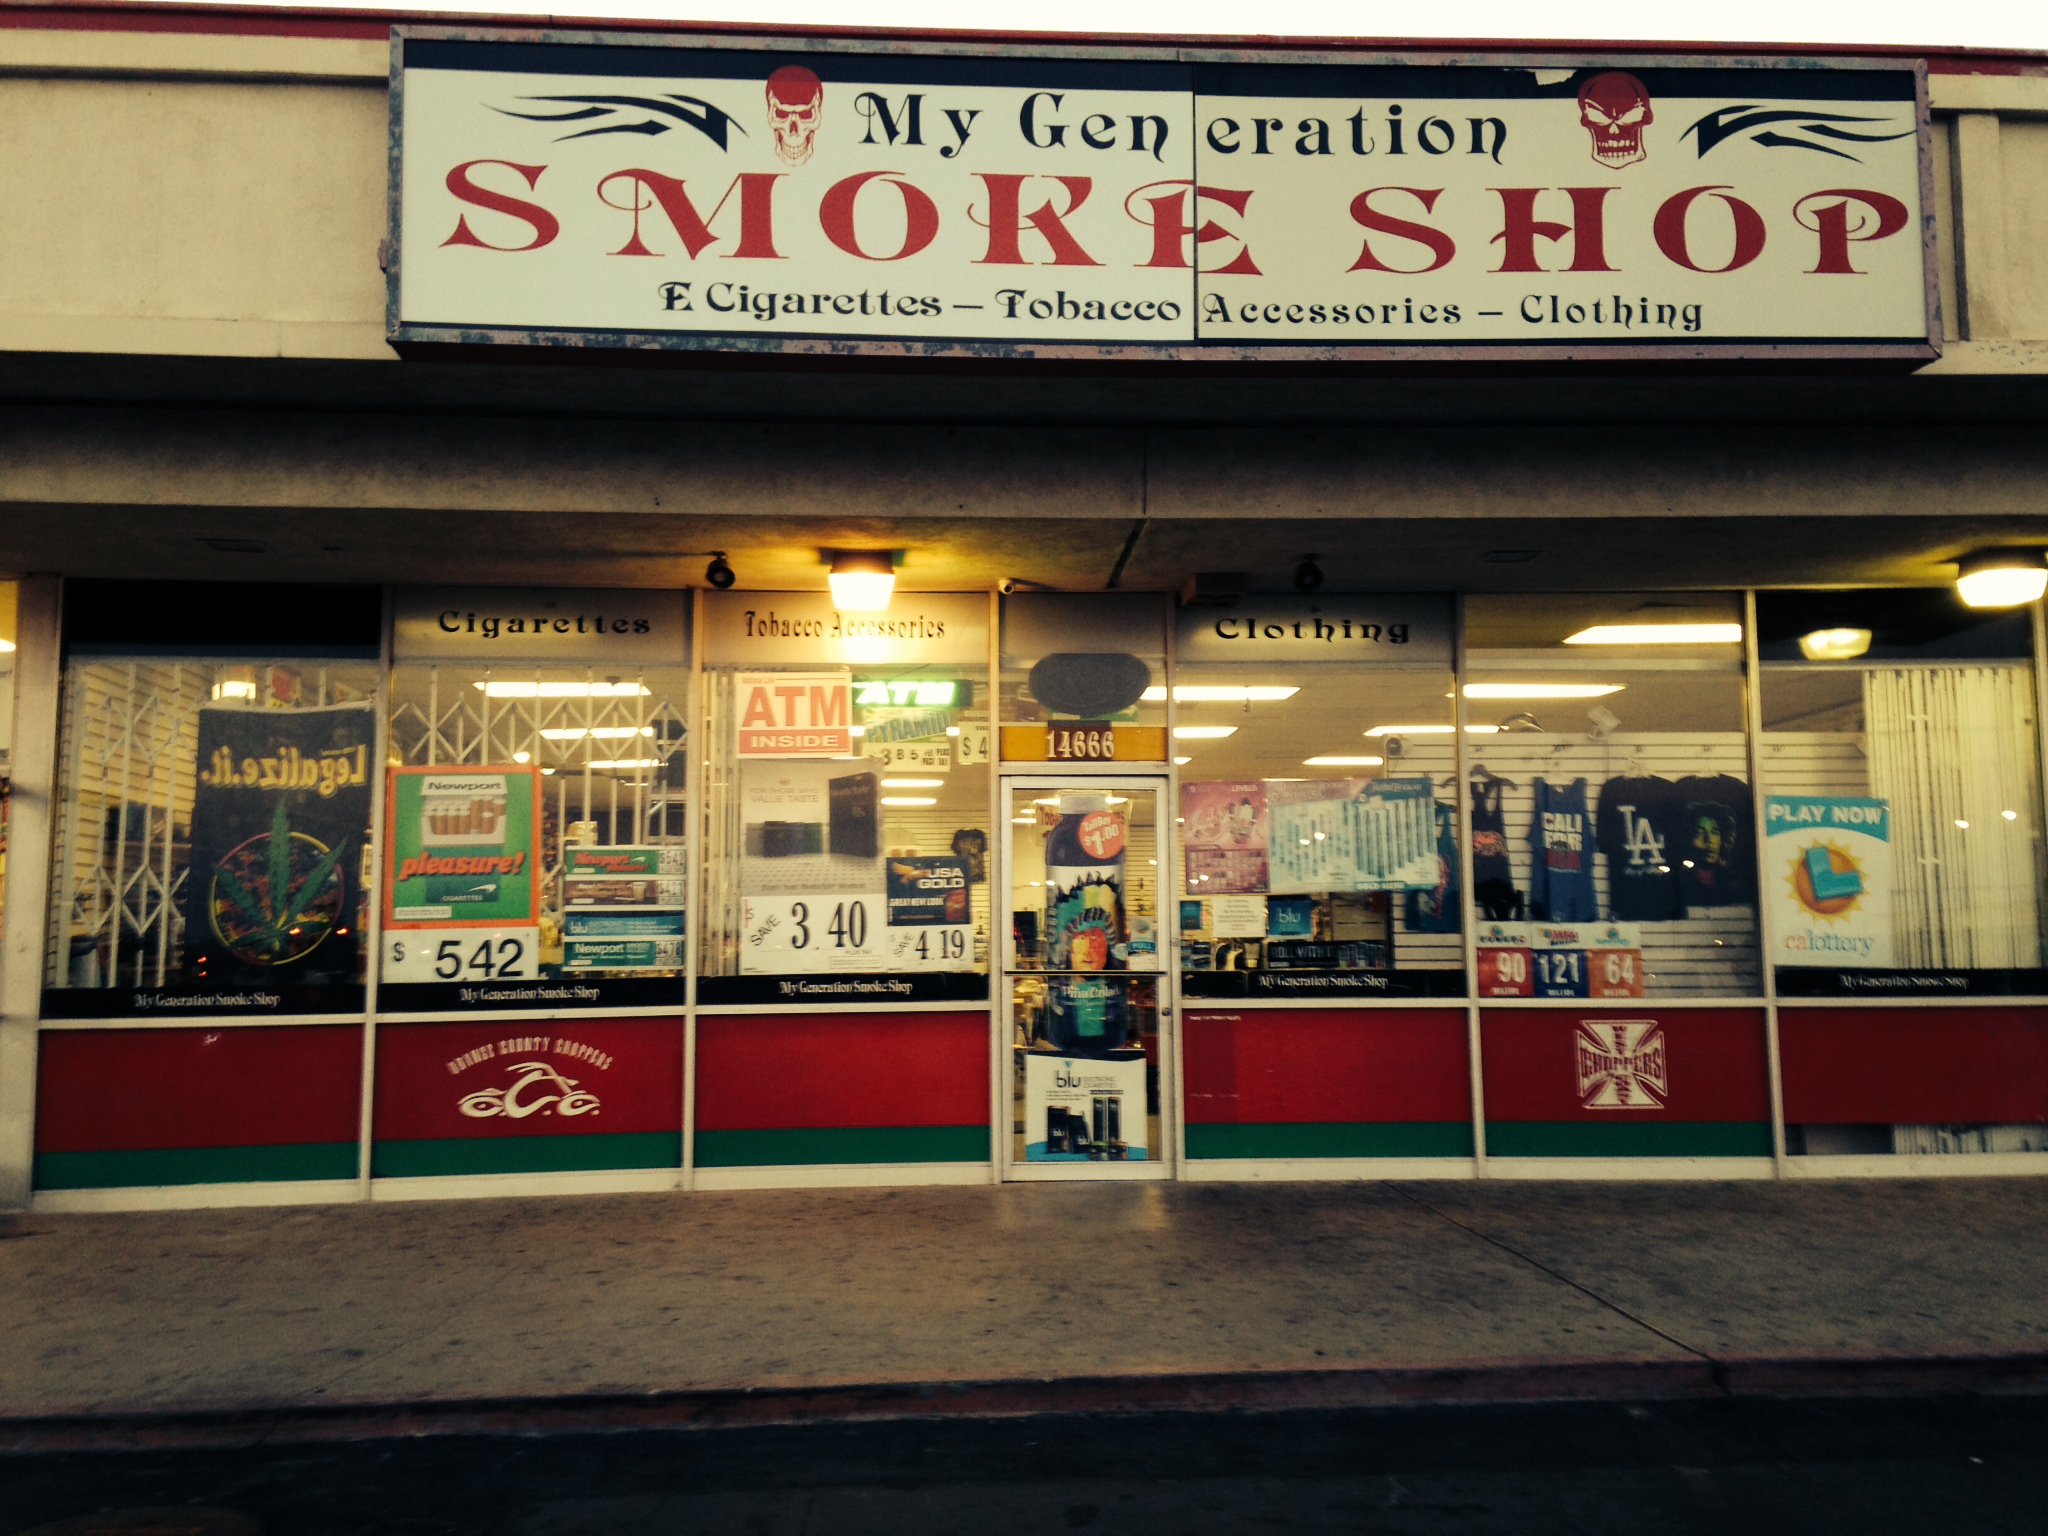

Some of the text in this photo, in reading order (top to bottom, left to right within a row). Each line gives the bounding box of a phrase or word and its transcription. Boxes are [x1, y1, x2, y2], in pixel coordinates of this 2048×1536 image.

[855, 91, 1508, 166] My Generation
[438, 158, 1909, 276] SMOKE SHOP
[659, 281, 693, 312] E
[705, 283, 943, 322] Cigarettes
[995, 288, 1182, 322] Tobacco
[1202, 293, 1463, 325] Accessories
[1520, 294, 1703, 332] Clothing
[439, 609, 651, 639] Cigarettes
[745, 610, 946, 639] Tobacco Accessories
[1215, 616, 1410, 645] Clothing
[852, 681, 956, 705] ATM
[742, 685, 848, 728] ATM
[751, 734, 839, 749] INSIDE
[1047, 730, 1115, 758] 14666
[428, 781, 503, 791] Newport
[751, 795, 819, 803] VALUE TASTE
[1541, 811, 1583, 833] CALI
[1768, 803, 1882, 825] PLAY NOW
[1542, 830, 1583, 852] FOR
[1616, 804, 1667, 866] LA
[396, 851, 527, 882] pleasure!
[927, 867, 965, 879] USA
[916, 878, 965, 889] GOLD
[1277, 907, 1301, 924] blu
[751, 913, 782, 948] SAVE
[575, 942, 626, 957] Newport
[1496, 951, 1527, 984] 90
[1538, 952, 1580, 985] 121
[1604, 953, 1635, 986] 64
[460, 985, 601, 1003] My Generation Smoke Shop
[779, 979, 913, 996] My Generation Smoke Shop
[1259, 974, 1389, 990] My Generation Smoke Shop
[133, 991, 281, 1010] My Generation Smoke Shop
[497, 1035, 551, 1056] COUNTY
[553, 1037, 614, 1071] CHOPPERS
[1055, 1069, 1082, 1089] blu
